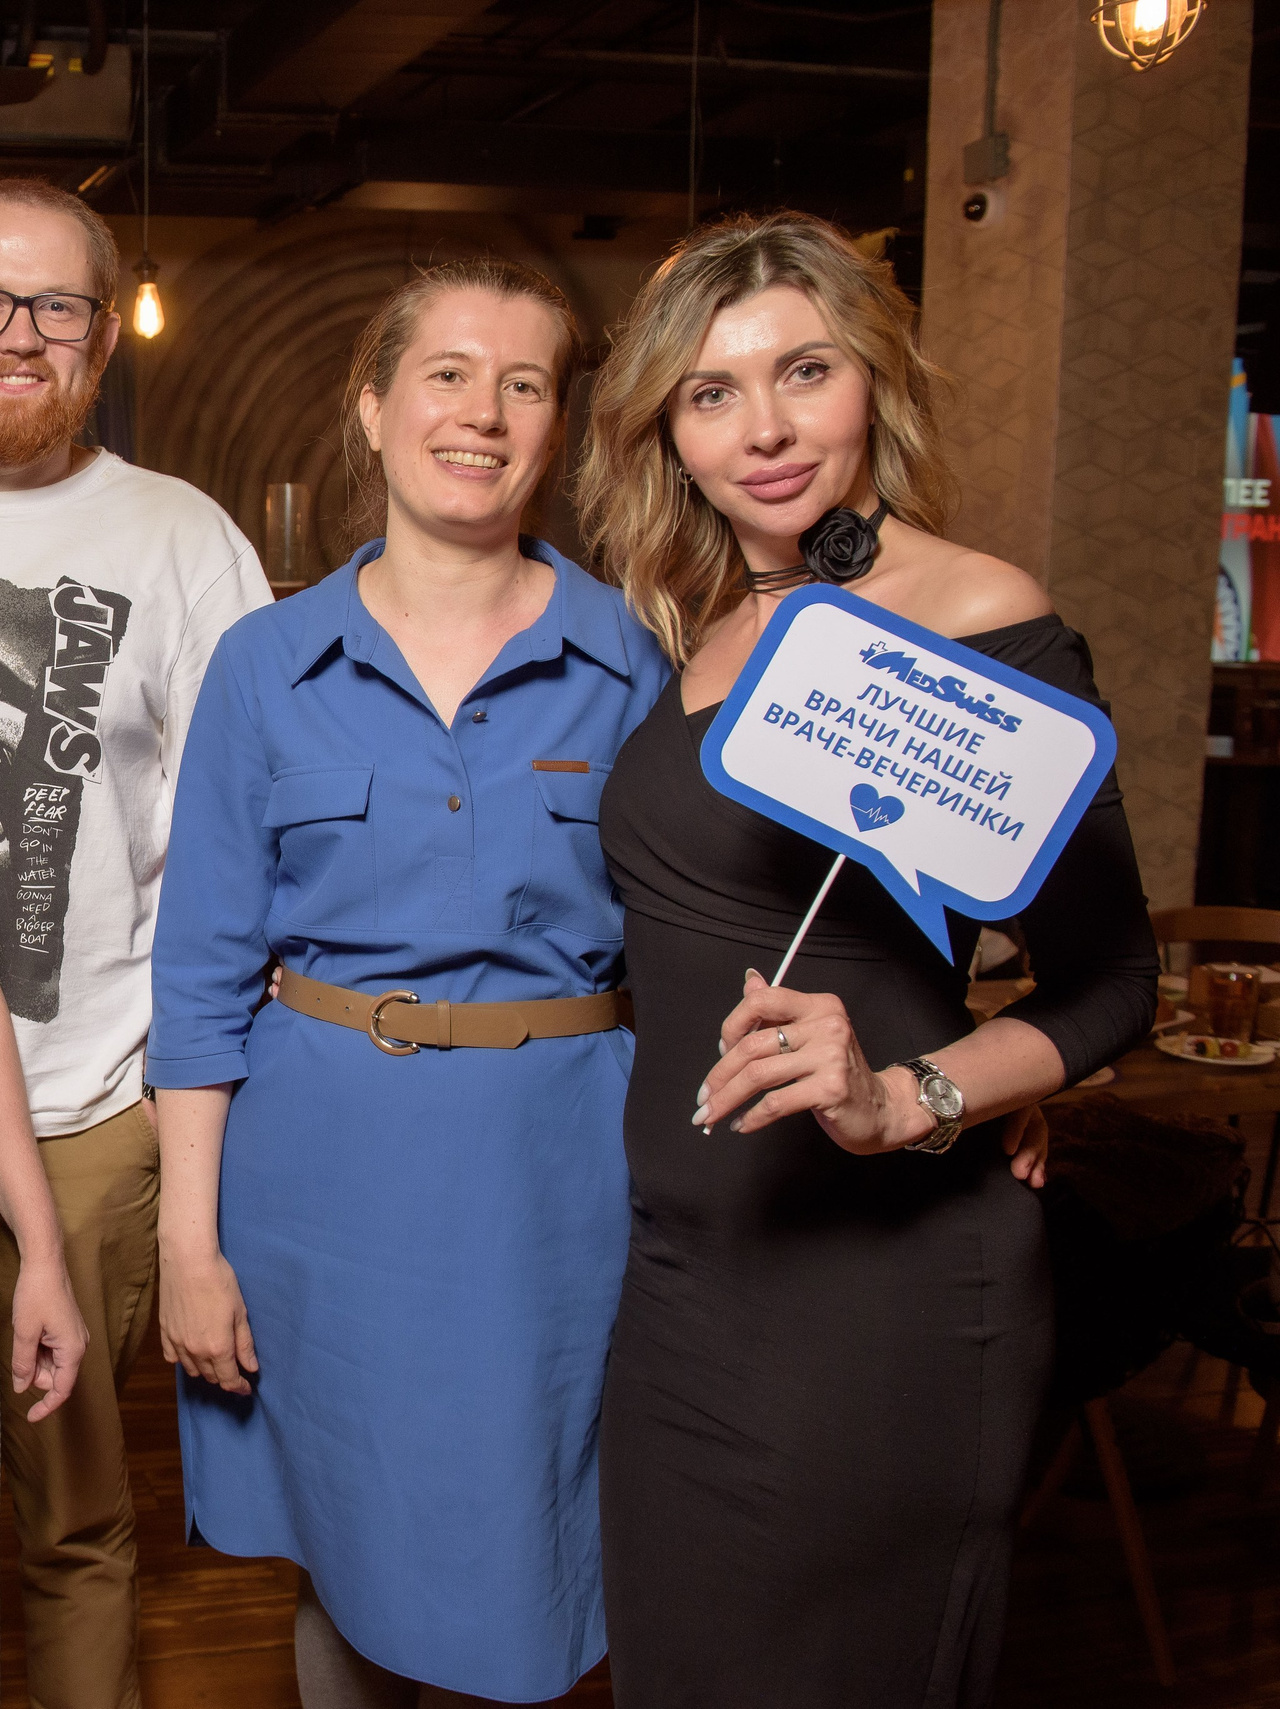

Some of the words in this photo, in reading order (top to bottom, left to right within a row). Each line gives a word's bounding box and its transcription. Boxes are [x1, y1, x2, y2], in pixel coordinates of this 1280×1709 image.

[44, 583, 114, 781] JAWS
[857, 683, 986, 755] ЛУЧШИЕ
[804, 688, 900, 748] ВРАЧИ
[902, 736, 1014, 801] НАШЕЙ
[762, 702, 1025, 842] ВРАЧЕ-ВЕЧЕРИНКИ
[23, 787, 70, 802] DEEP
[24, 801, 67, 820] FEAR
[22, 823, 63, 838] DON'T
[20, 838, 40, 851] GO
[42, 843, 53, 853] IN
[26, 855, 49, 866] THE
[18, 868, 56, 882] WATER
[16, 890, 52, 902] GONNA
[22, 902, 51, 914] NEED
[16, 918, 55, 932] BIGGER
[19, 933, 48, 945] BOAT
